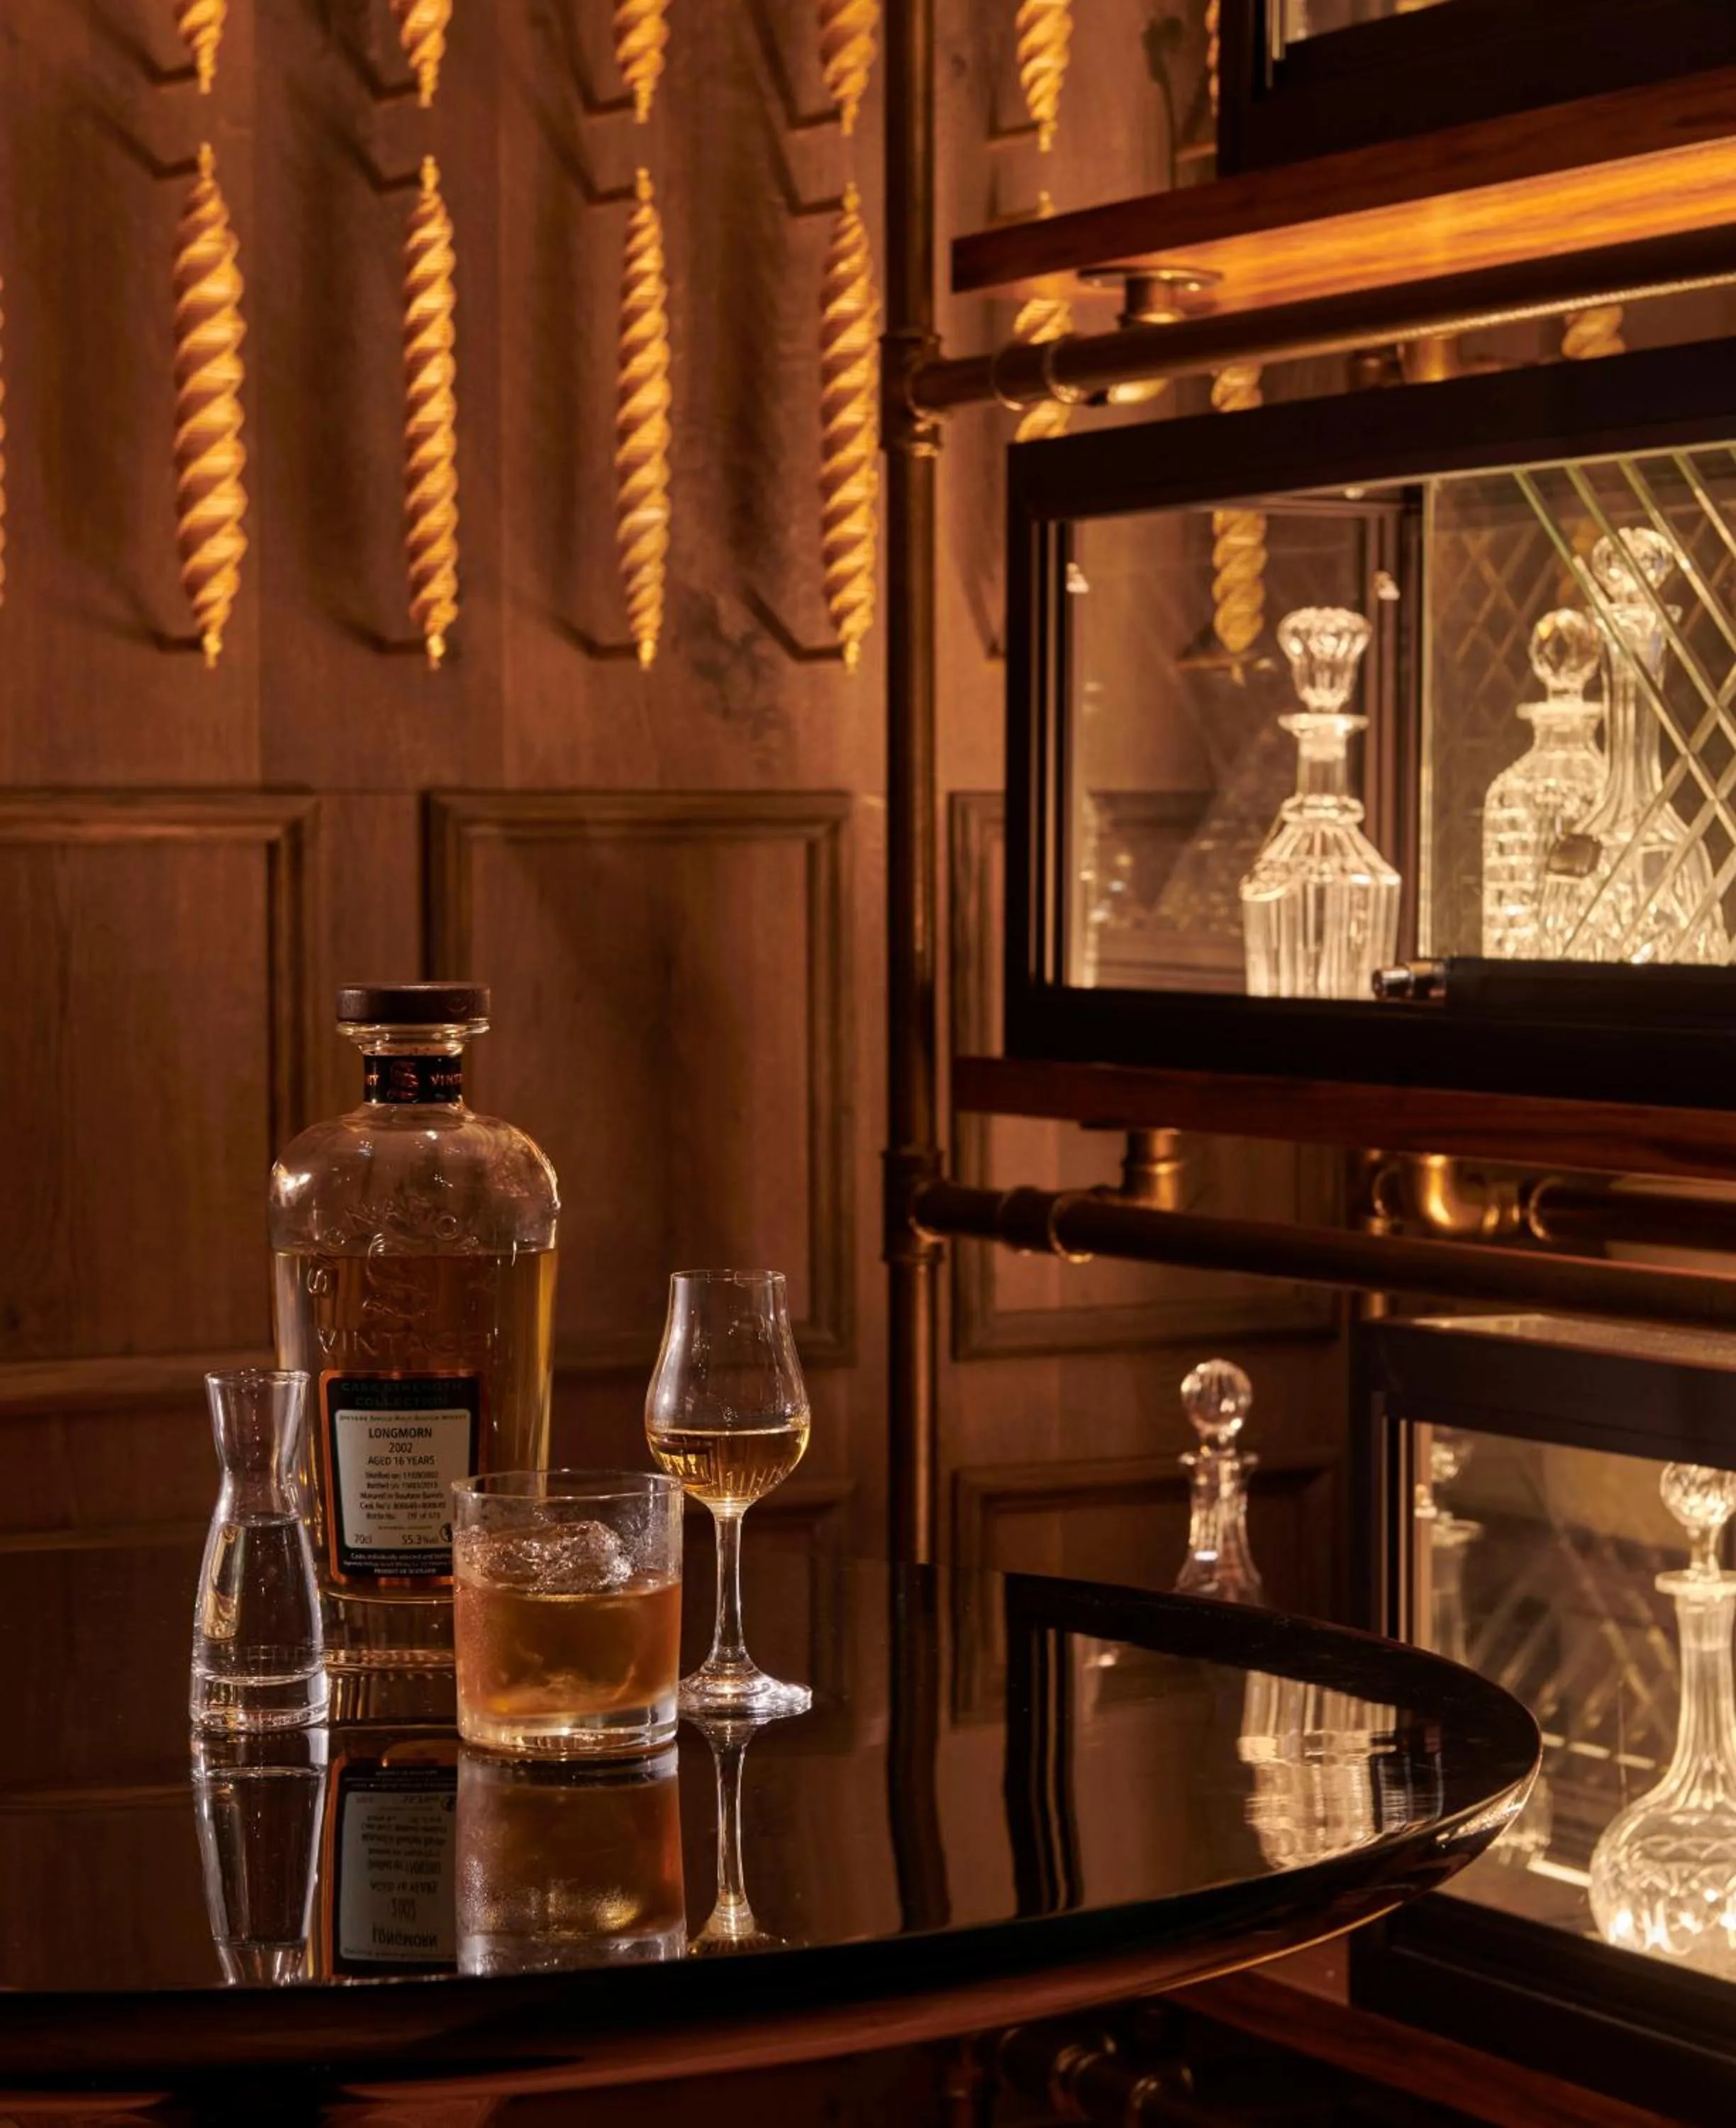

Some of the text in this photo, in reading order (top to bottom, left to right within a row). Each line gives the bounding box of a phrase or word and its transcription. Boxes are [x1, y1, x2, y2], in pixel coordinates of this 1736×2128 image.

[368, 1427, 432, 1439] LONGMORN
[389, 1442, 413, 1453] 2002
[367, 1455, 435, 1465] AGED 16 YEARS
[354, 1533, 372, 1544] 70cl
